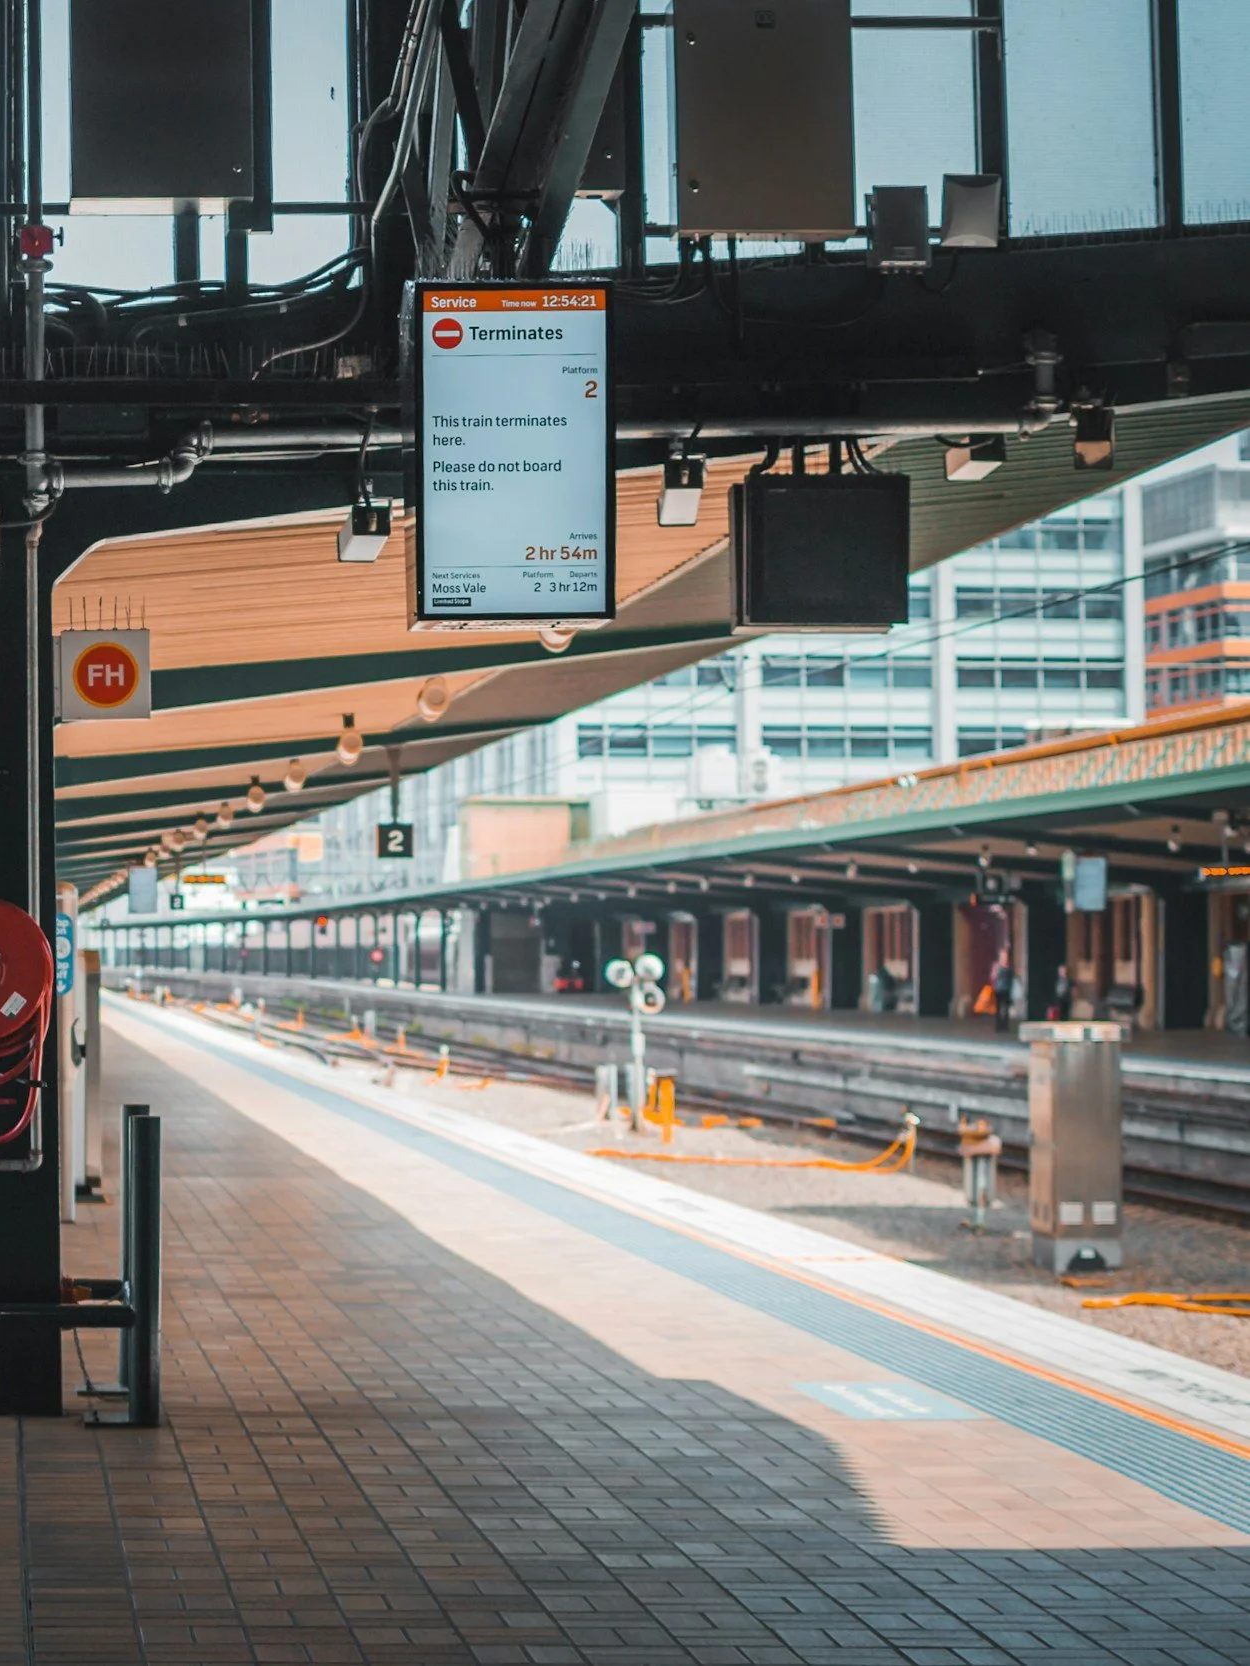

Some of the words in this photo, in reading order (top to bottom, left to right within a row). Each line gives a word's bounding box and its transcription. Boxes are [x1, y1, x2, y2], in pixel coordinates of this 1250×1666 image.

[431, 296, 476, 308] Service
[502, 299, 520, 308] Time
[542, 295, 596, 308] 12:54:21
[469, 326, 563, 341] Terminates
[562, 366, 598, 375] Platform
[585, 381, 597, 398] 2
[433, 415, 460, 427] This
[462, 415, 492, 427] train
[496, 414, 567, 427] terminates
[433, 434, 465, 446] here.
[433, 461, 476, 473] Please
[479, 460, 495, 472] do
[498, 462, 520, 472] not
[523, 460, 562, 472] board
[433, 479, 457, 491] this
[460, 479, 494, 491] train.
[570, 532, 597, 540] Arrives
[525, 547, 535, 560] 2
[539, 546, 557, 560] hr
[560, 546, 597, 560] 54m
[570, 571, 598, 579] Departs
[432, 583, 460, 594] Moss
[463, 582, 486, 593] Vale
[534, 582, 541, 592] 2
[550, 582, 557, 592] 3
[559, 582, 571, 592] hr
[573, 582, 597, 592] 12m
[88, 664, 125, 687] FH
[388, 831, 404, 851] 2
